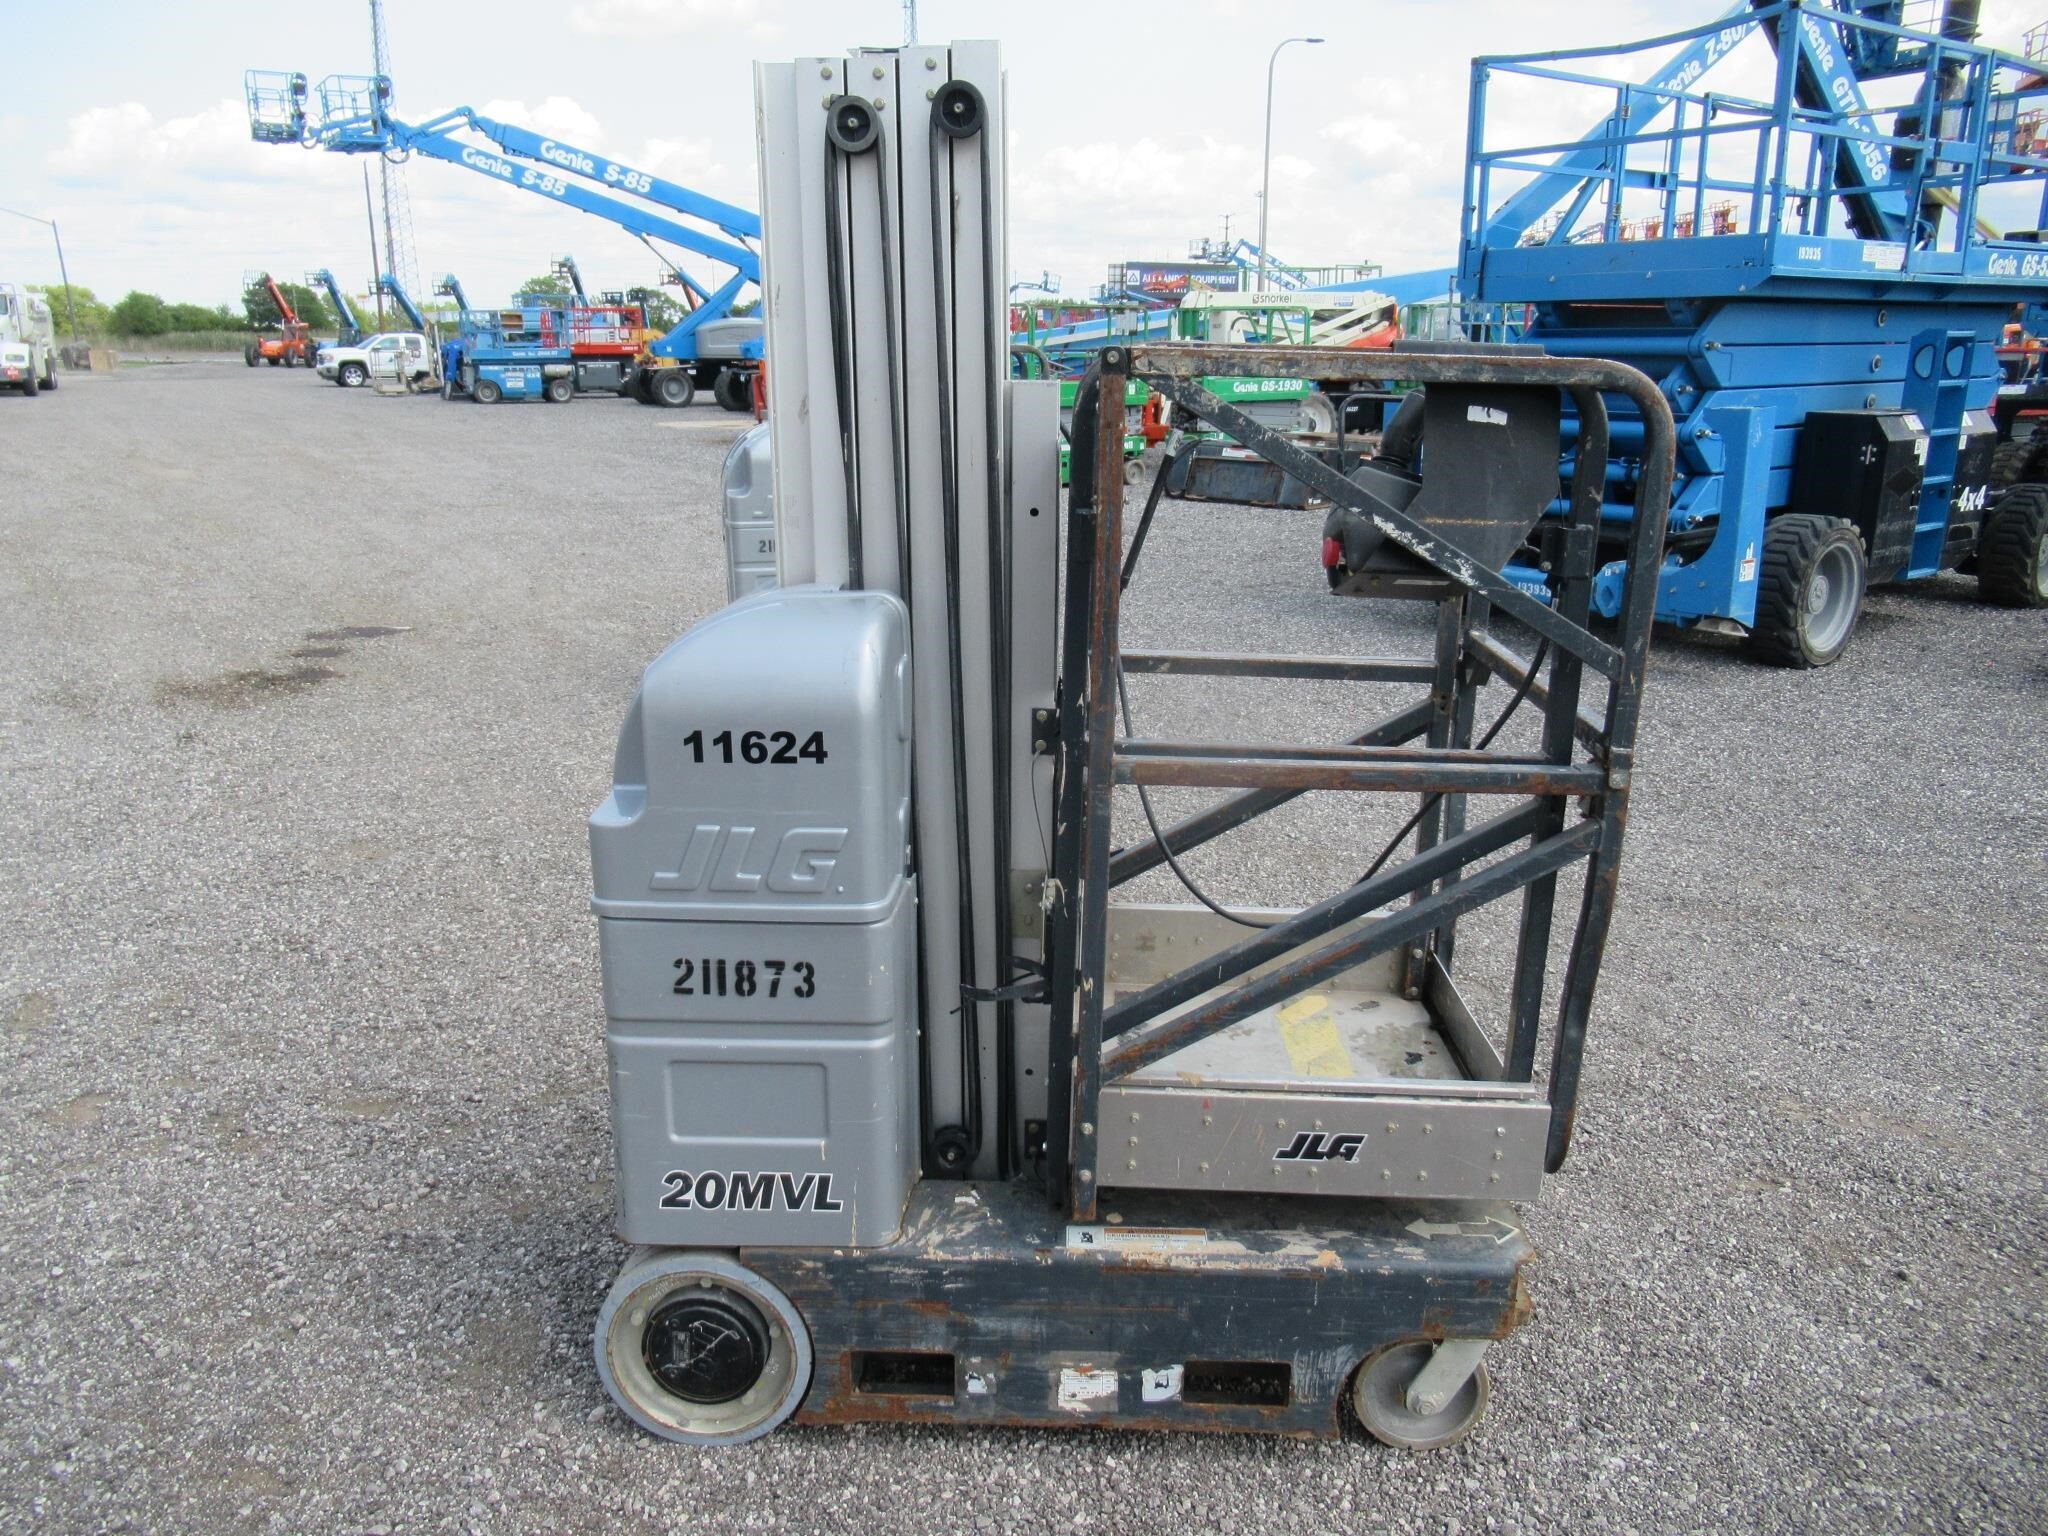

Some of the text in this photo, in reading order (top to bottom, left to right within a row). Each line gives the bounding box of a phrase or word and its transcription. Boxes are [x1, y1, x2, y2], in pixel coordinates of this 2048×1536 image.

[462, 147, 568, 196] Genie S-85
[540, 140, 653, 193] Genie S-85
[1988, 252, 2018, 276] Genie
[1260, 294, 1292, 304] snorkel
[1233, 379, 1303, 393] Genie GS-1930
[1957, 485, 1987, 512] 4x4
[683, 730, 828, 764] 11624
[650, 824, 848, 892] JLG
[673, 957, 816, 998] 211873
[1273, 1131, 1368, 1163] JLG
[659, 1169, 844, 1212] 20MVL
